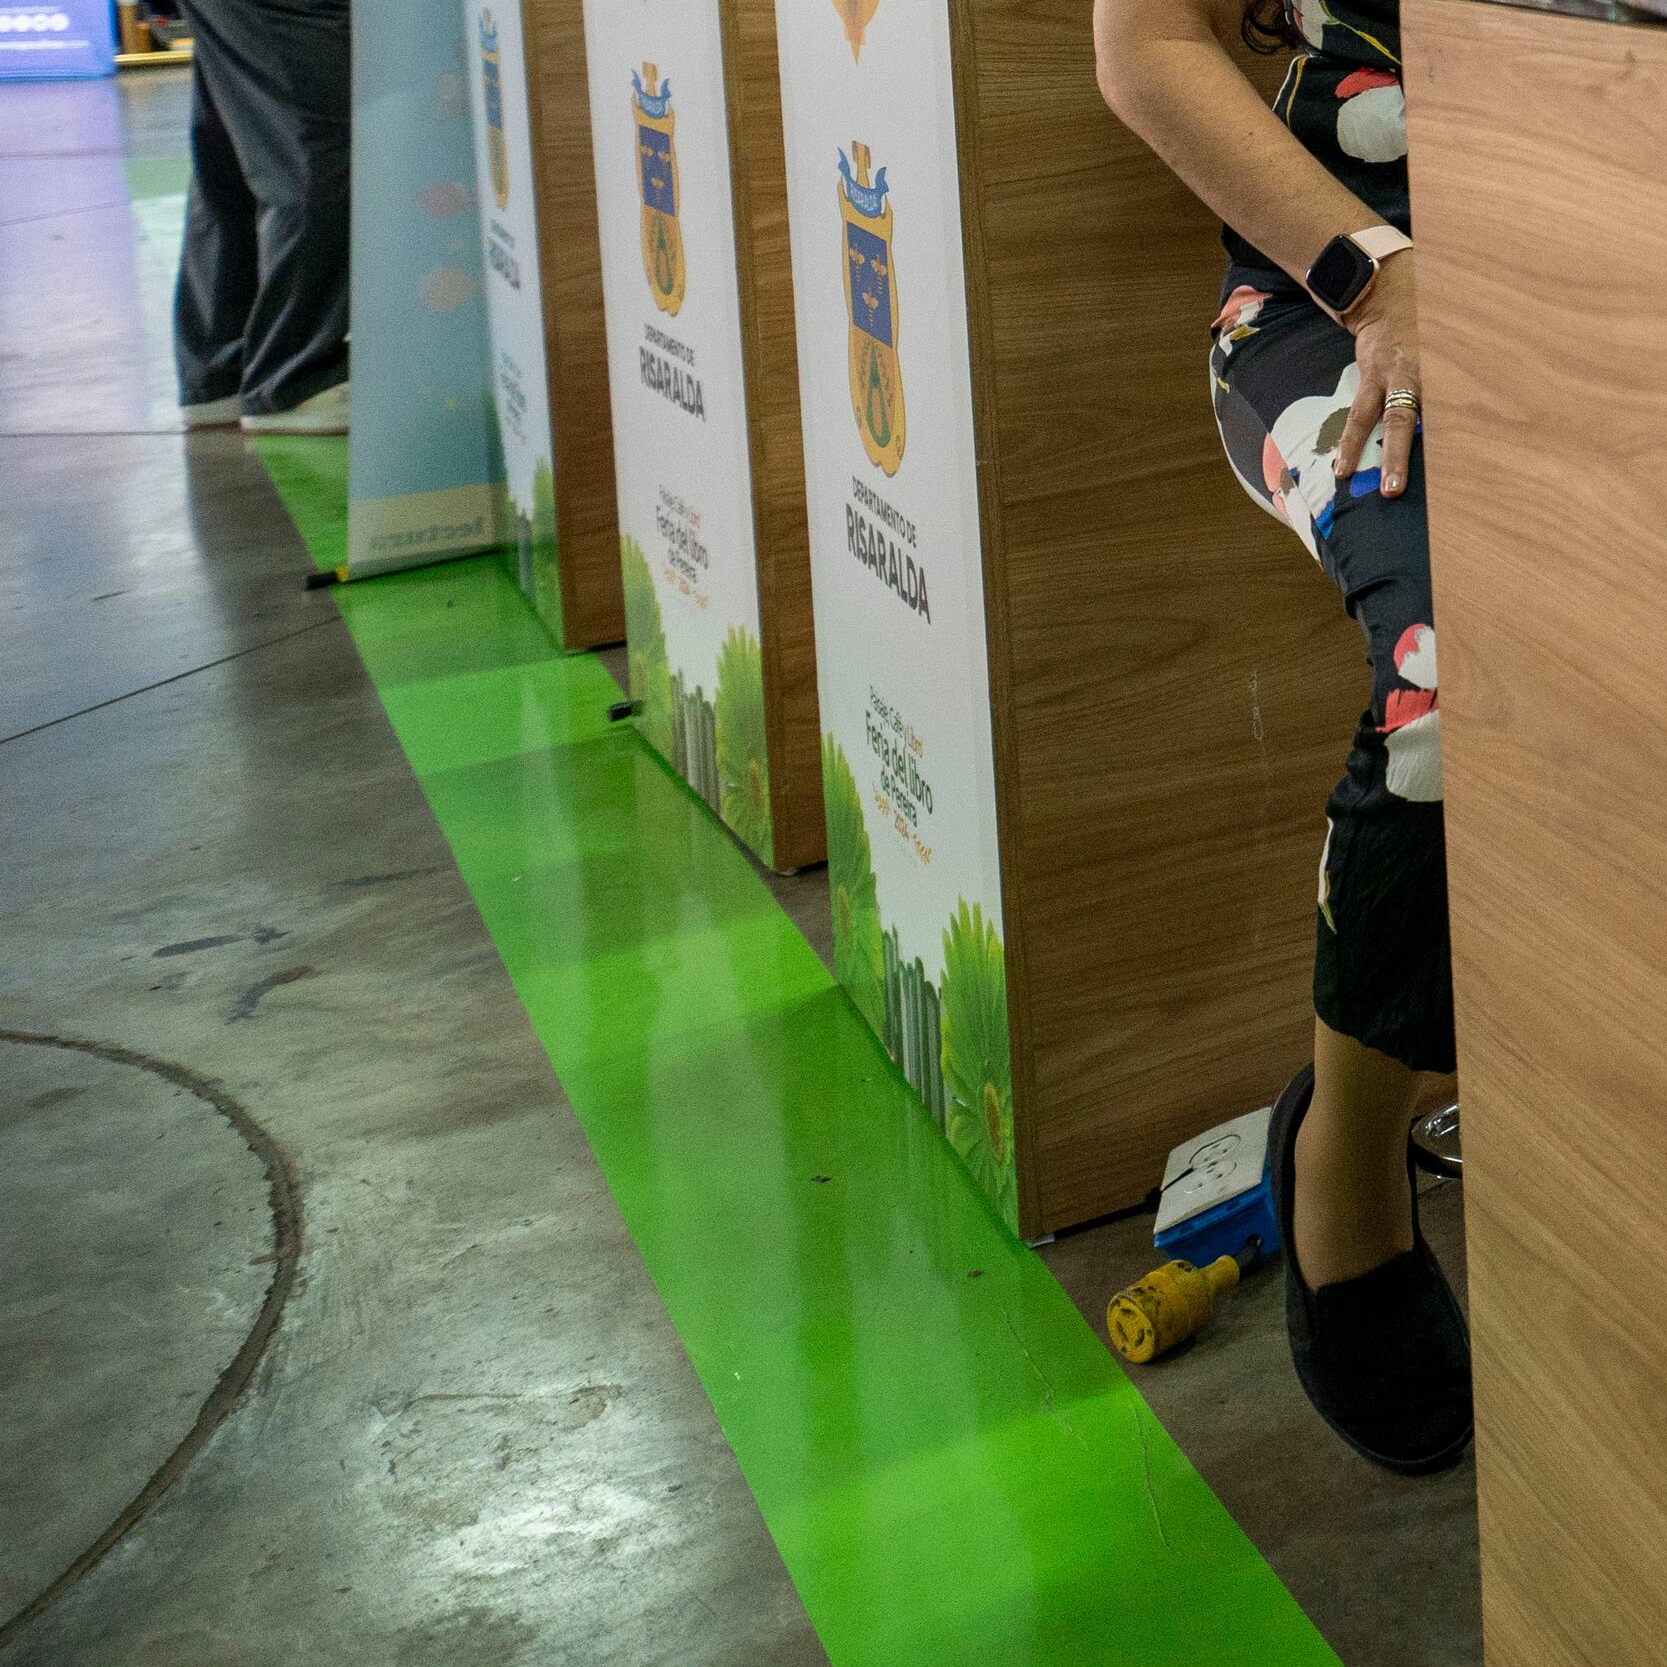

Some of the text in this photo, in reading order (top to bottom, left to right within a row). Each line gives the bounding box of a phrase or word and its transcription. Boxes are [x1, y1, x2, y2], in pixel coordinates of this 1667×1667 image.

[639, 345, 705, 423] RISARALDA
[852, 475, 917, 550] DEPARTAMENTO DE
[845, 502, 931, 625] RISARALDA
[866, 709, 934, 815] Feria del libro
